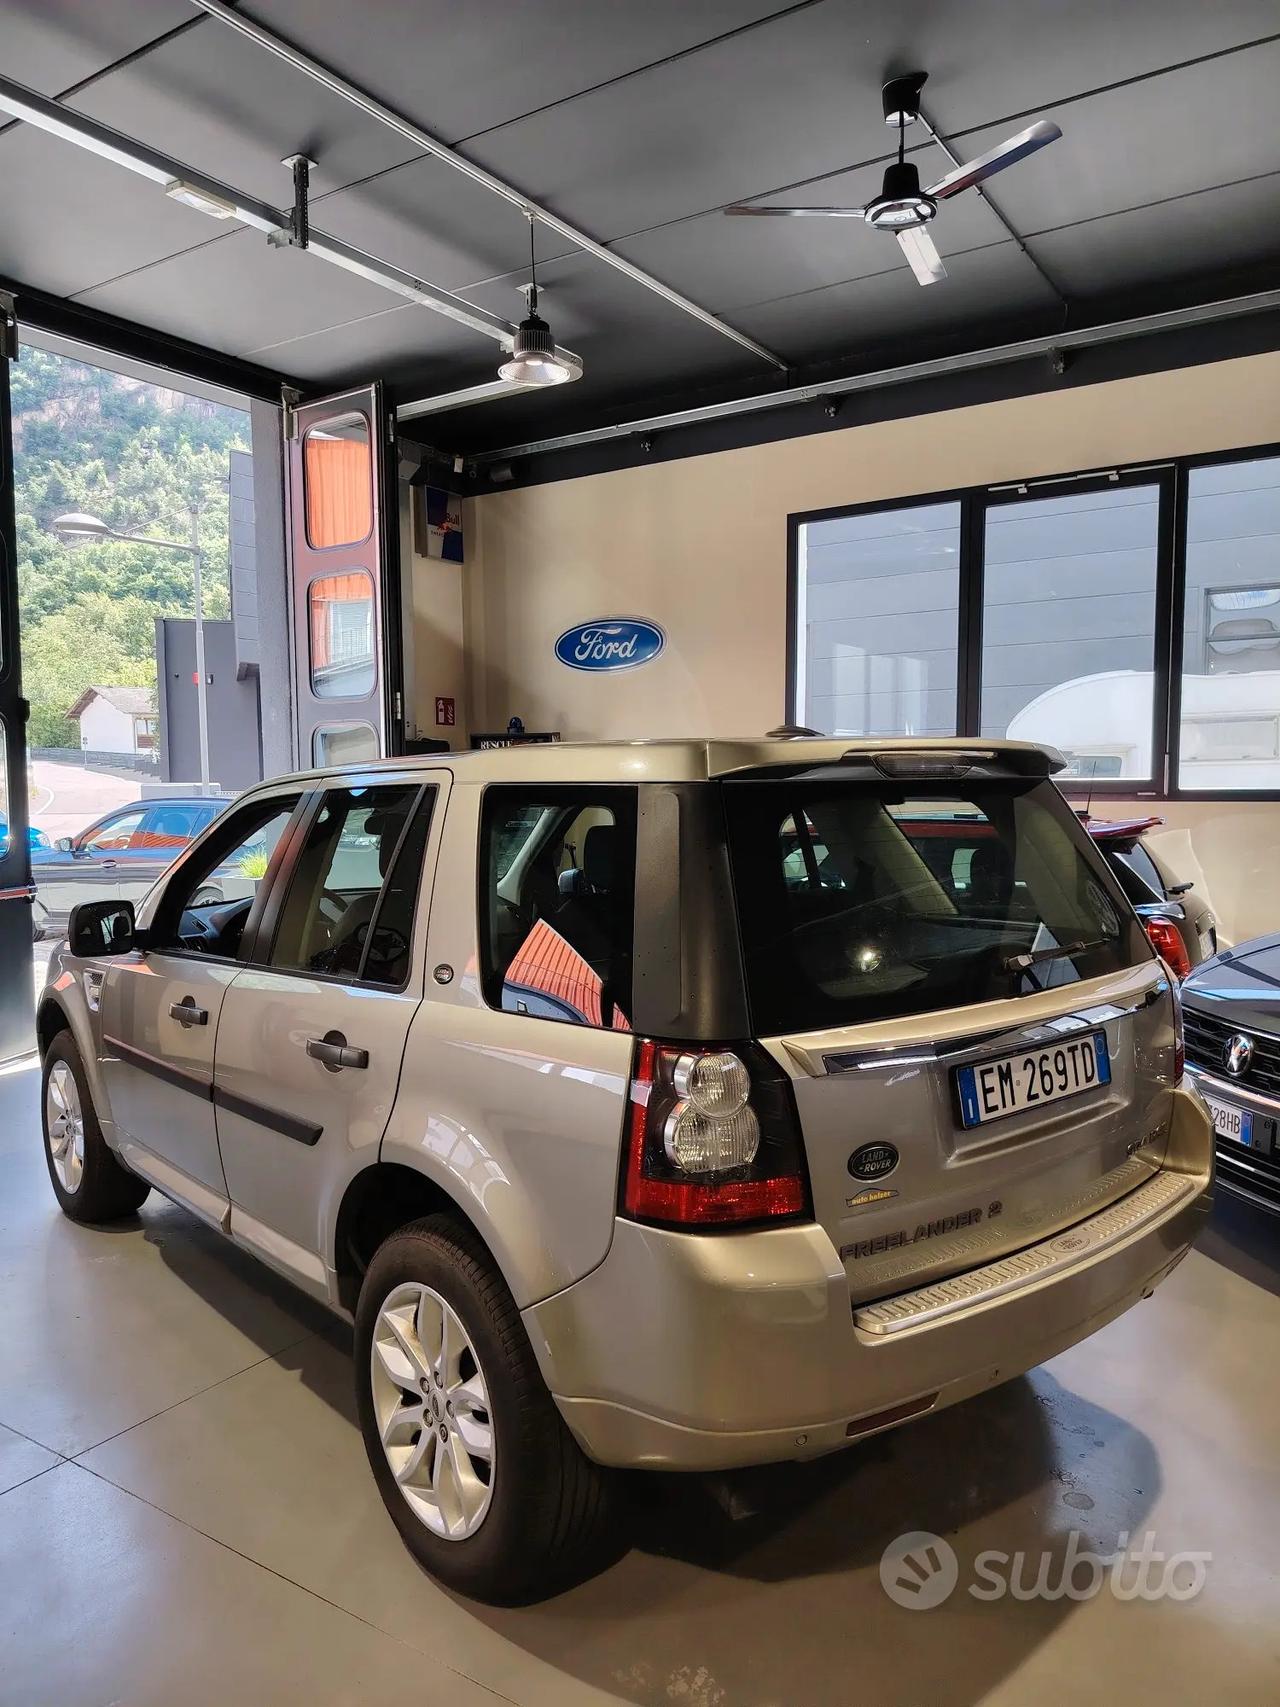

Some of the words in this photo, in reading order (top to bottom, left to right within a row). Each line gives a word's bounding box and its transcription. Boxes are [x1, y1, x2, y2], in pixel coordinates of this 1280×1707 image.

[575, 627, 638, 661] Ford
[980, 1062, 1016, 1114] EM
[1023, 1042, 1096, 1102] 269TD
[1208, 1105, 1241, 1134] 28HB
[862, 1151, 884, 1163] LAND
[864, 1160, 891, 1172] ROVER
[840, 1207, 983, 1262] FREELANDER
[988, 1200, 1003, 1218] 2
